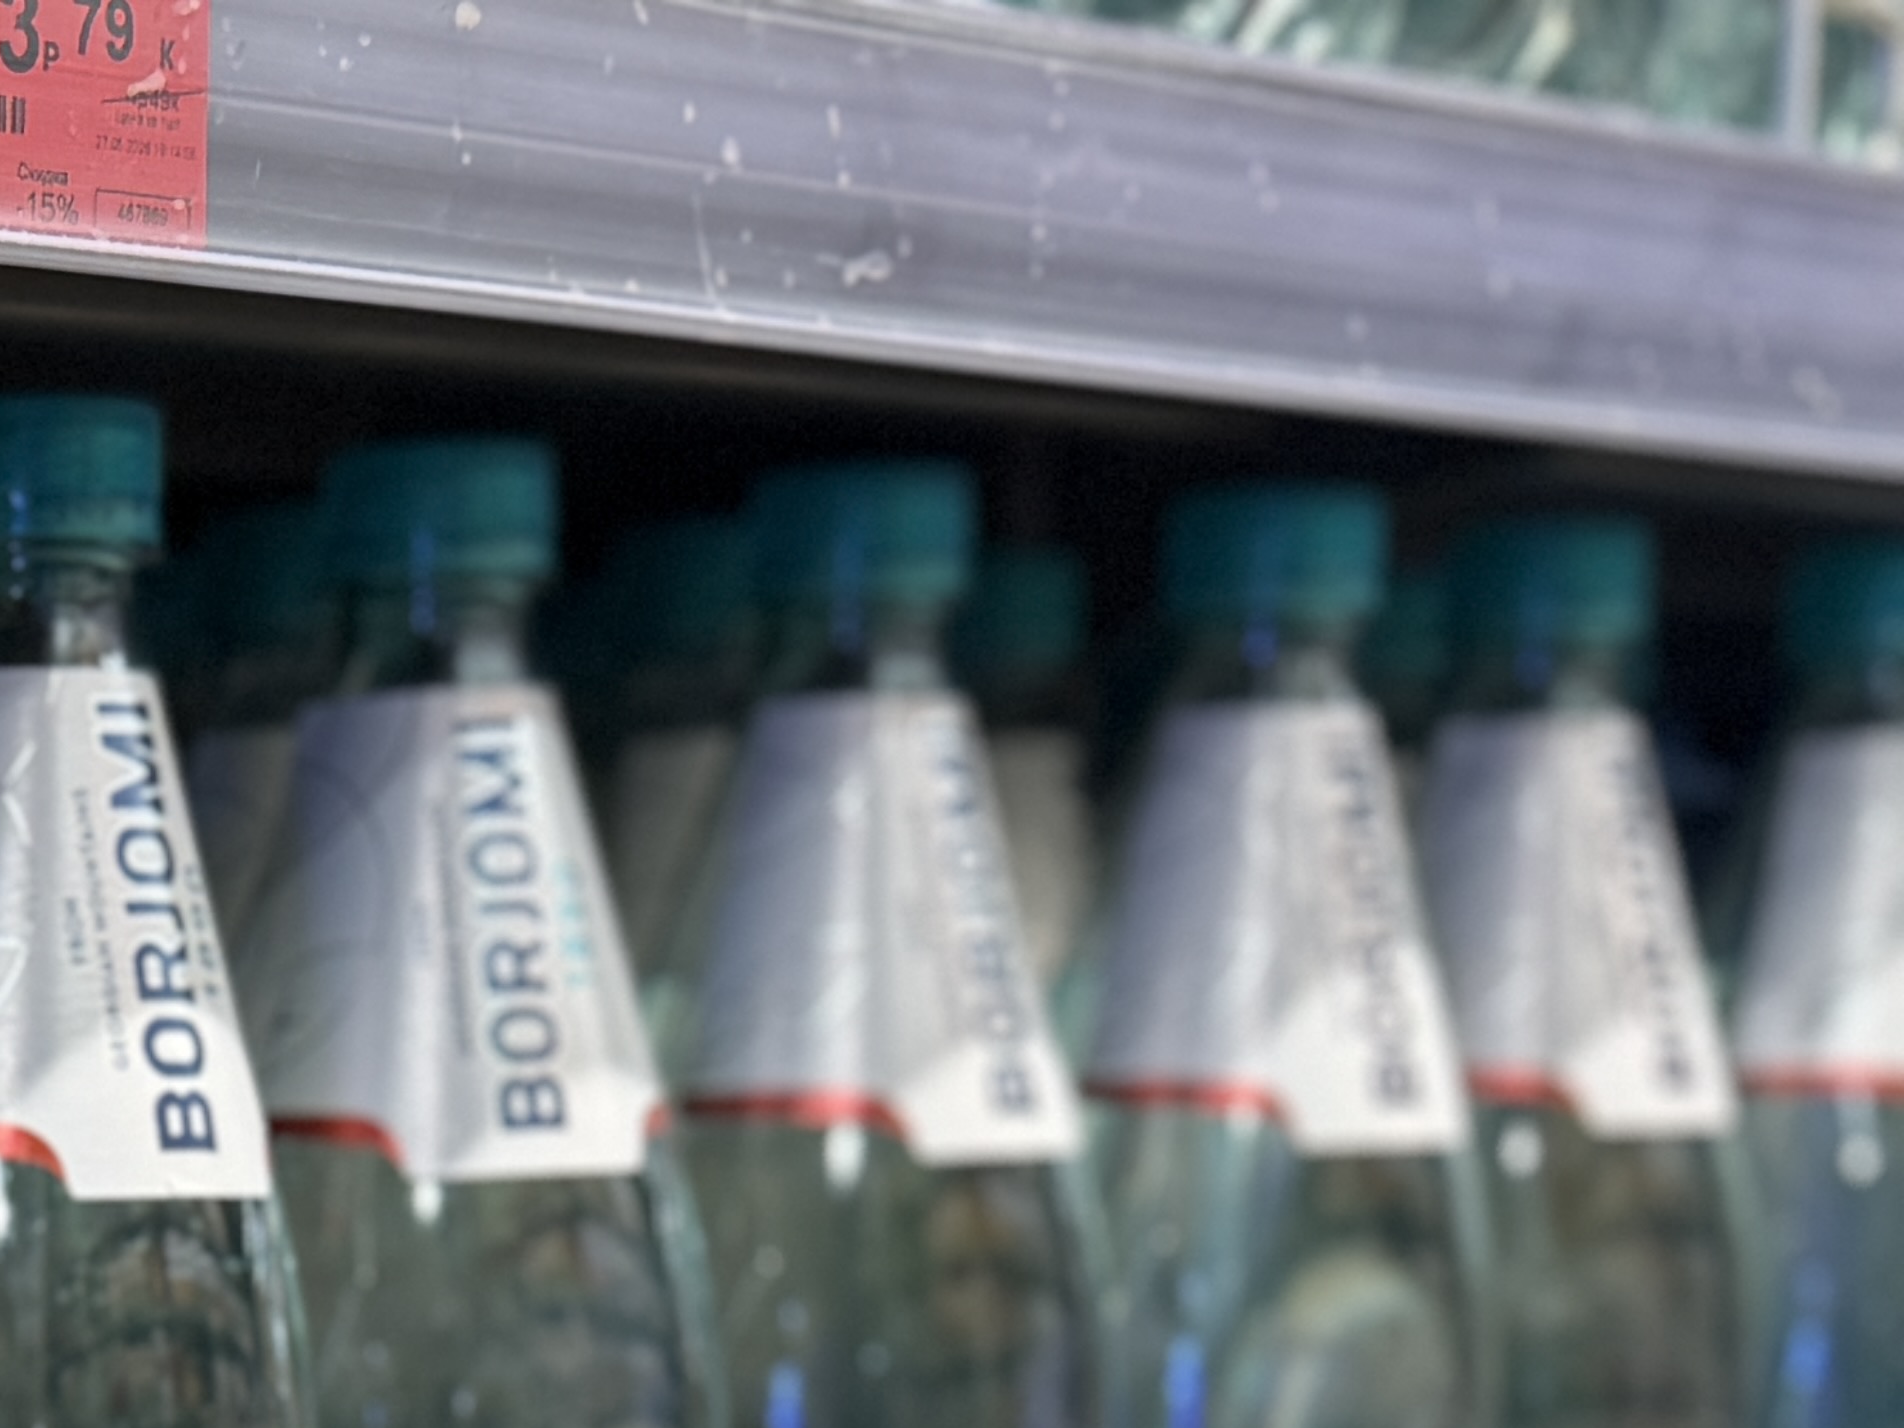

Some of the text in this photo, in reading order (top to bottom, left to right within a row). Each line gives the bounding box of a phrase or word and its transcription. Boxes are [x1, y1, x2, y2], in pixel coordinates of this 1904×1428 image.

[74, 0, 134, 62] 79
[16, 191, 80, 226] -15%
[96, 700, 217, 1154] BORJOMI
[451, 710, 569, 1133] BORJOMI
